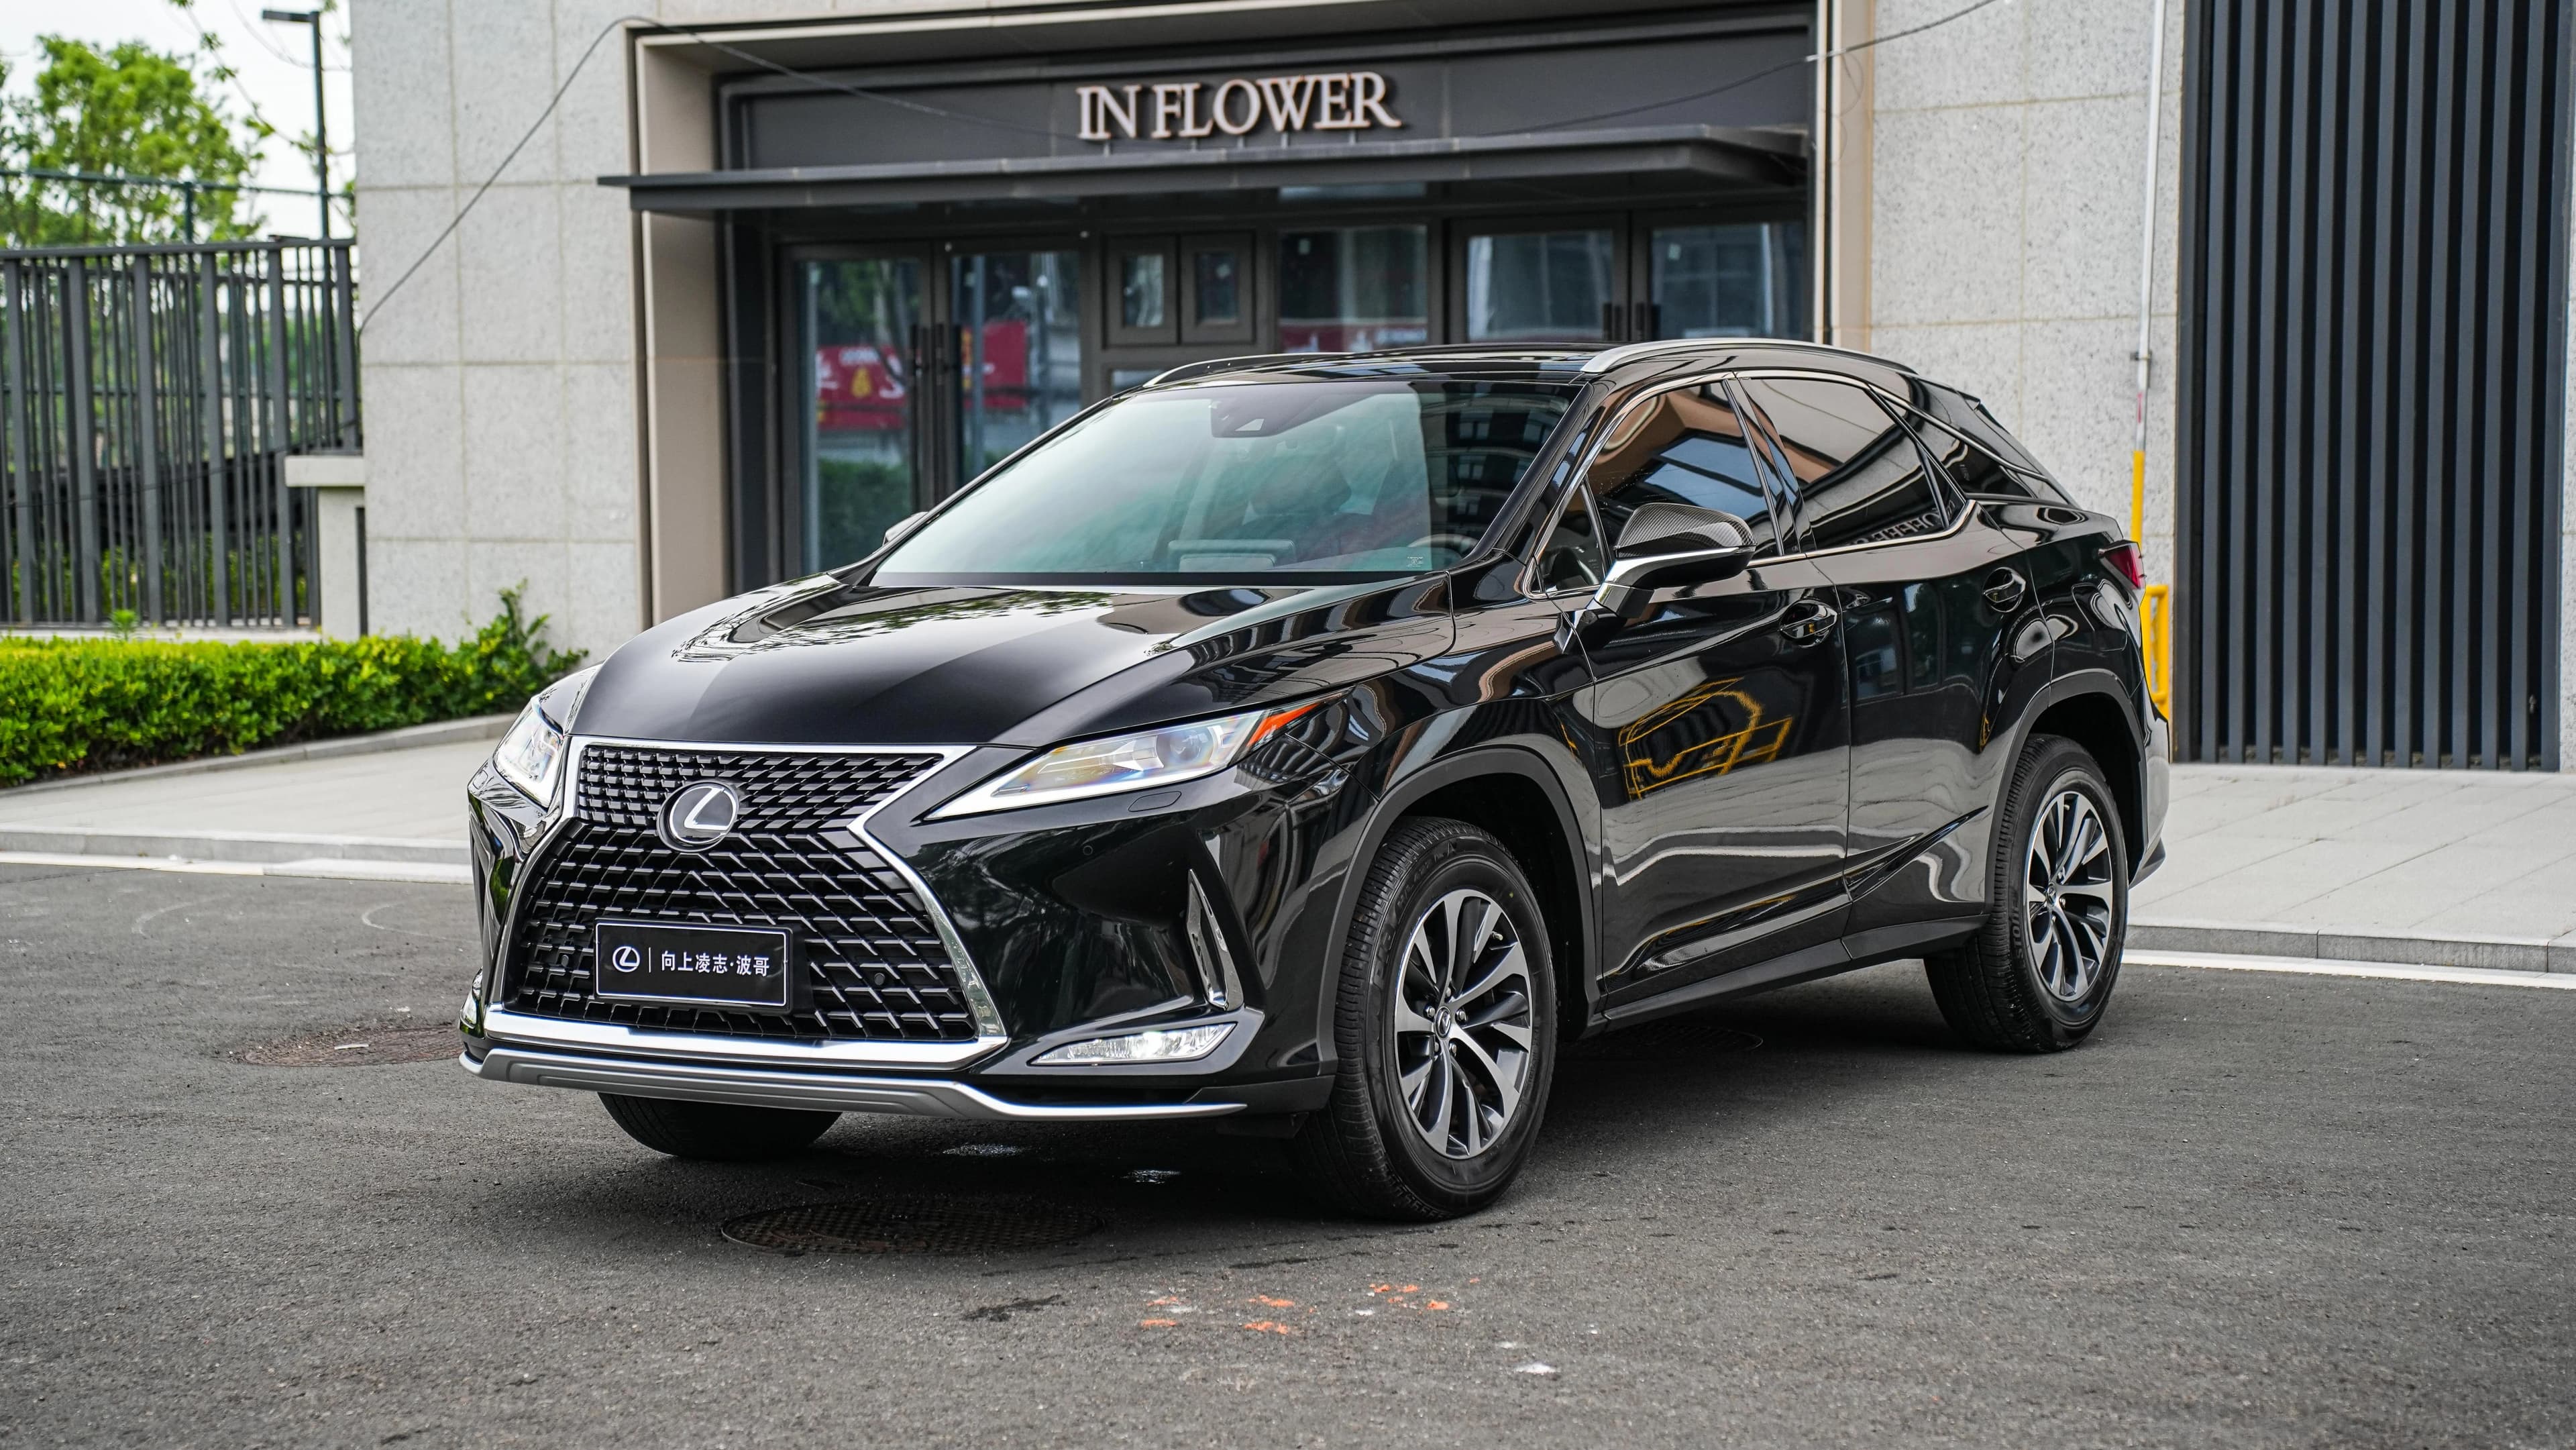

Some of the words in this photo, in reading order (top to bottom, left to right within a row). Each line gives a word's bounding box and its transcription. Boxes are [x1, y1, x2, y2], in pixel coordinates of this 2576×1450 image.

[1076, 85, 1141, 139] IN
[1151, 71, 1402, 139] FLOWER
[661, 950, 769, 977] 向上凌志·波哥
